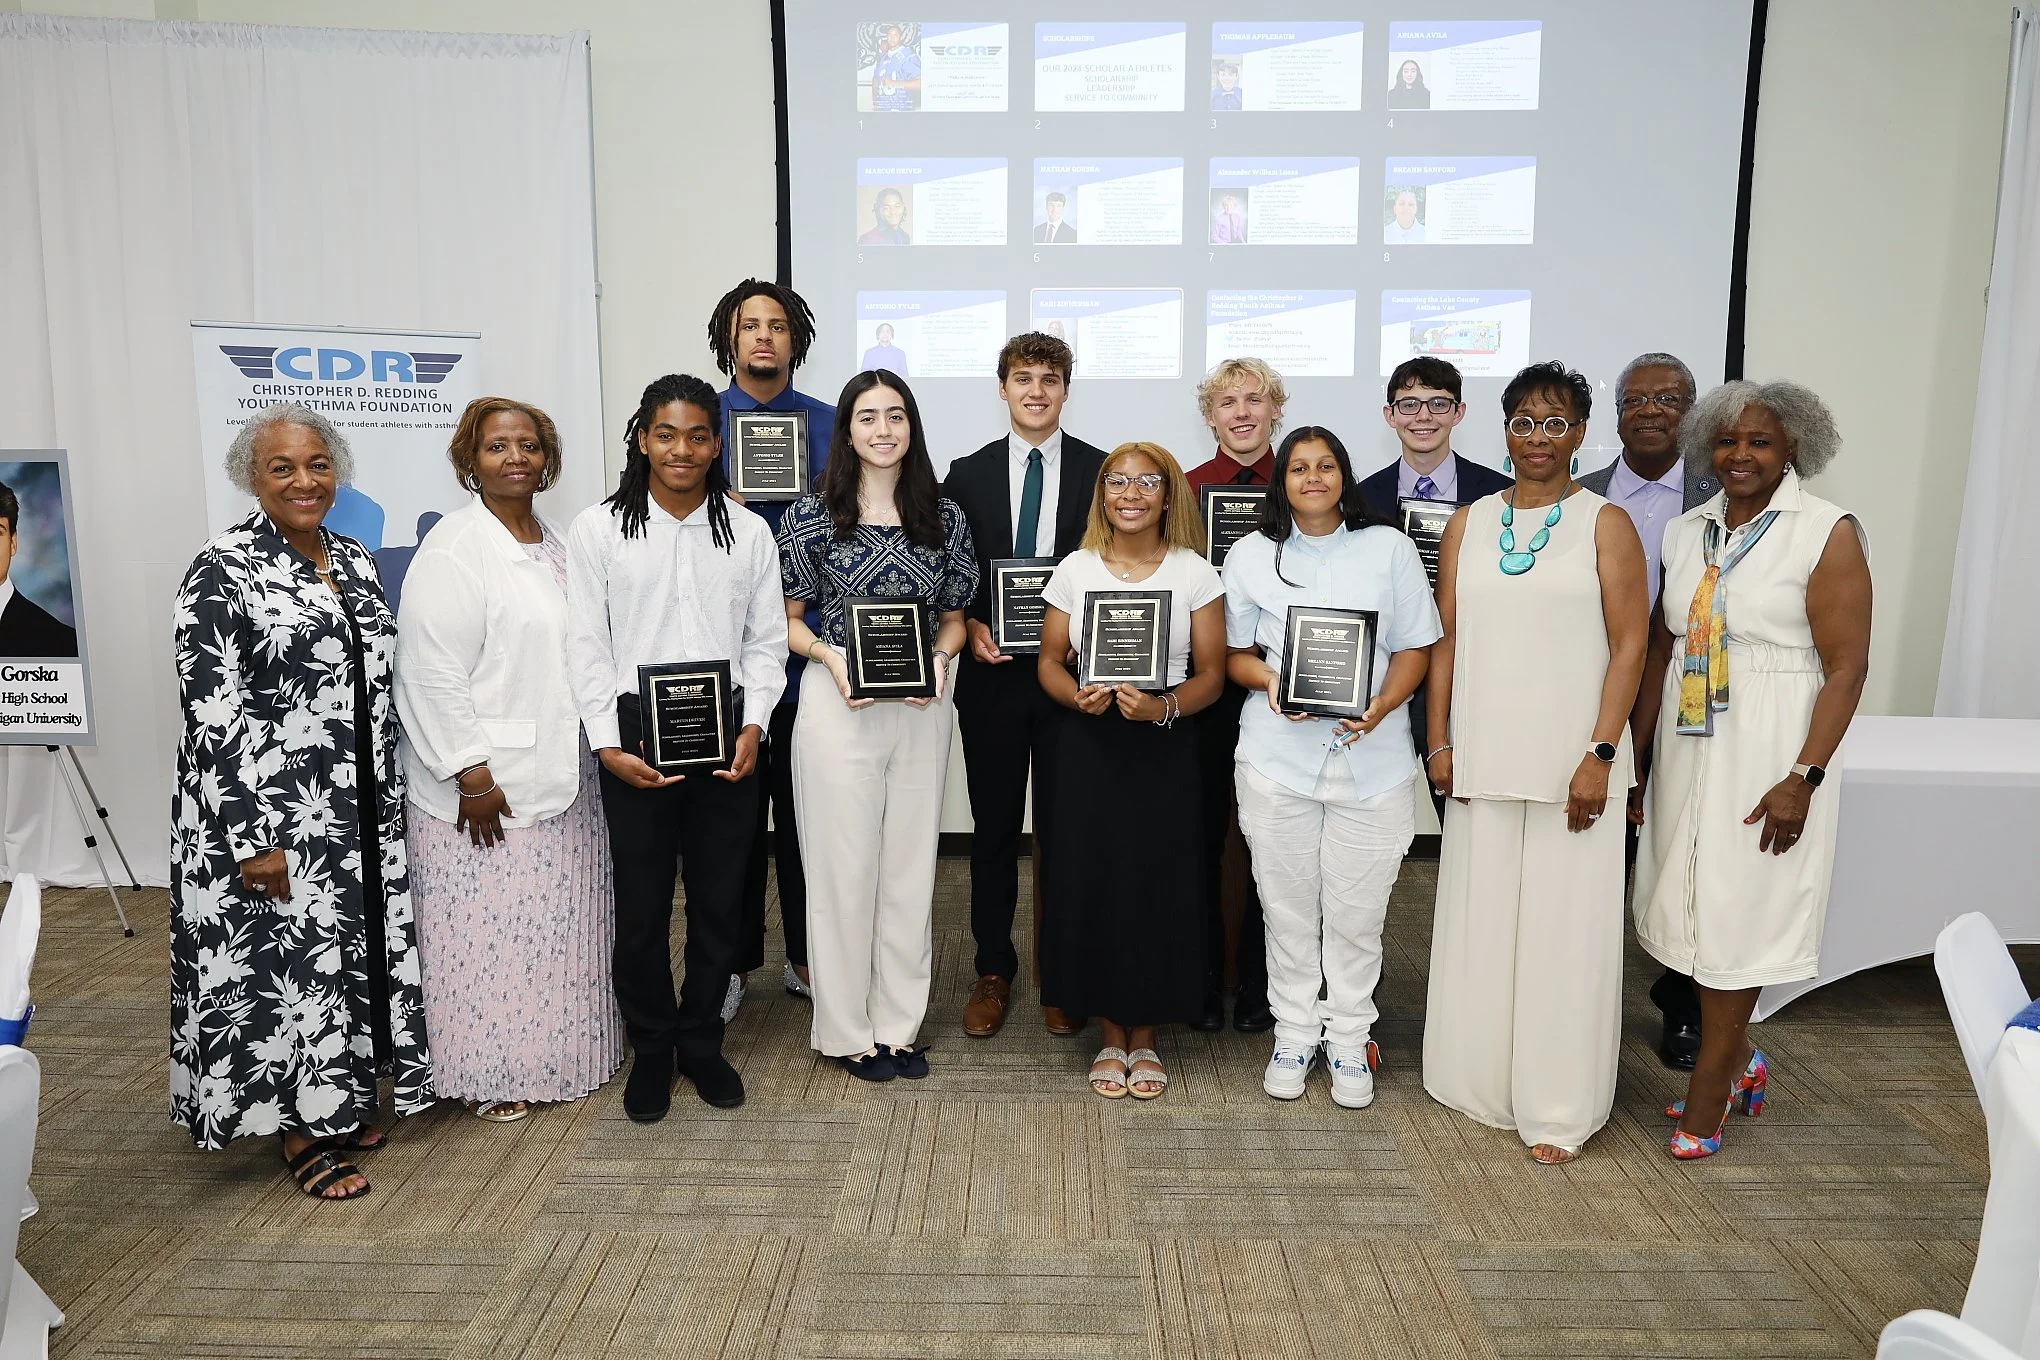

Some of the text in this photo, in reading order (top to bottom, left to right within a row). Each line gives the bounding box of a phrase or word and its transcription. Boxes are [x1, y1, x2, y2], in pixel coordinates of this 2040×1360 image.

[945, 46, 986, 55] CDR
[1042, 64, 1172, 72] OUR 2024 SCHOLAR ATHLETES
[1087, 84, 1136, 92] LEADERSHIP
[1034, 120, 1041, 130] 2
[1211, 119, 1217, 129] 3
[1387, 118, 1394, 128] 4
[858, 253, 864, 263] 5
[1033, 253, 1040, 263] 6
[1208, 253, 1214, 263] 7
[1384, 252, 1390, 262] 8
[275, 347, 413, 383] CDR
[252, 384, 438, 399] CHRISTOPHER D. REDDING
[360, 401, 452, 413] FOUNDATION
[1, 666, 59, 681] Gorska
[2, 692, 68, 706] High School
[26, 712, 82, 726] University
